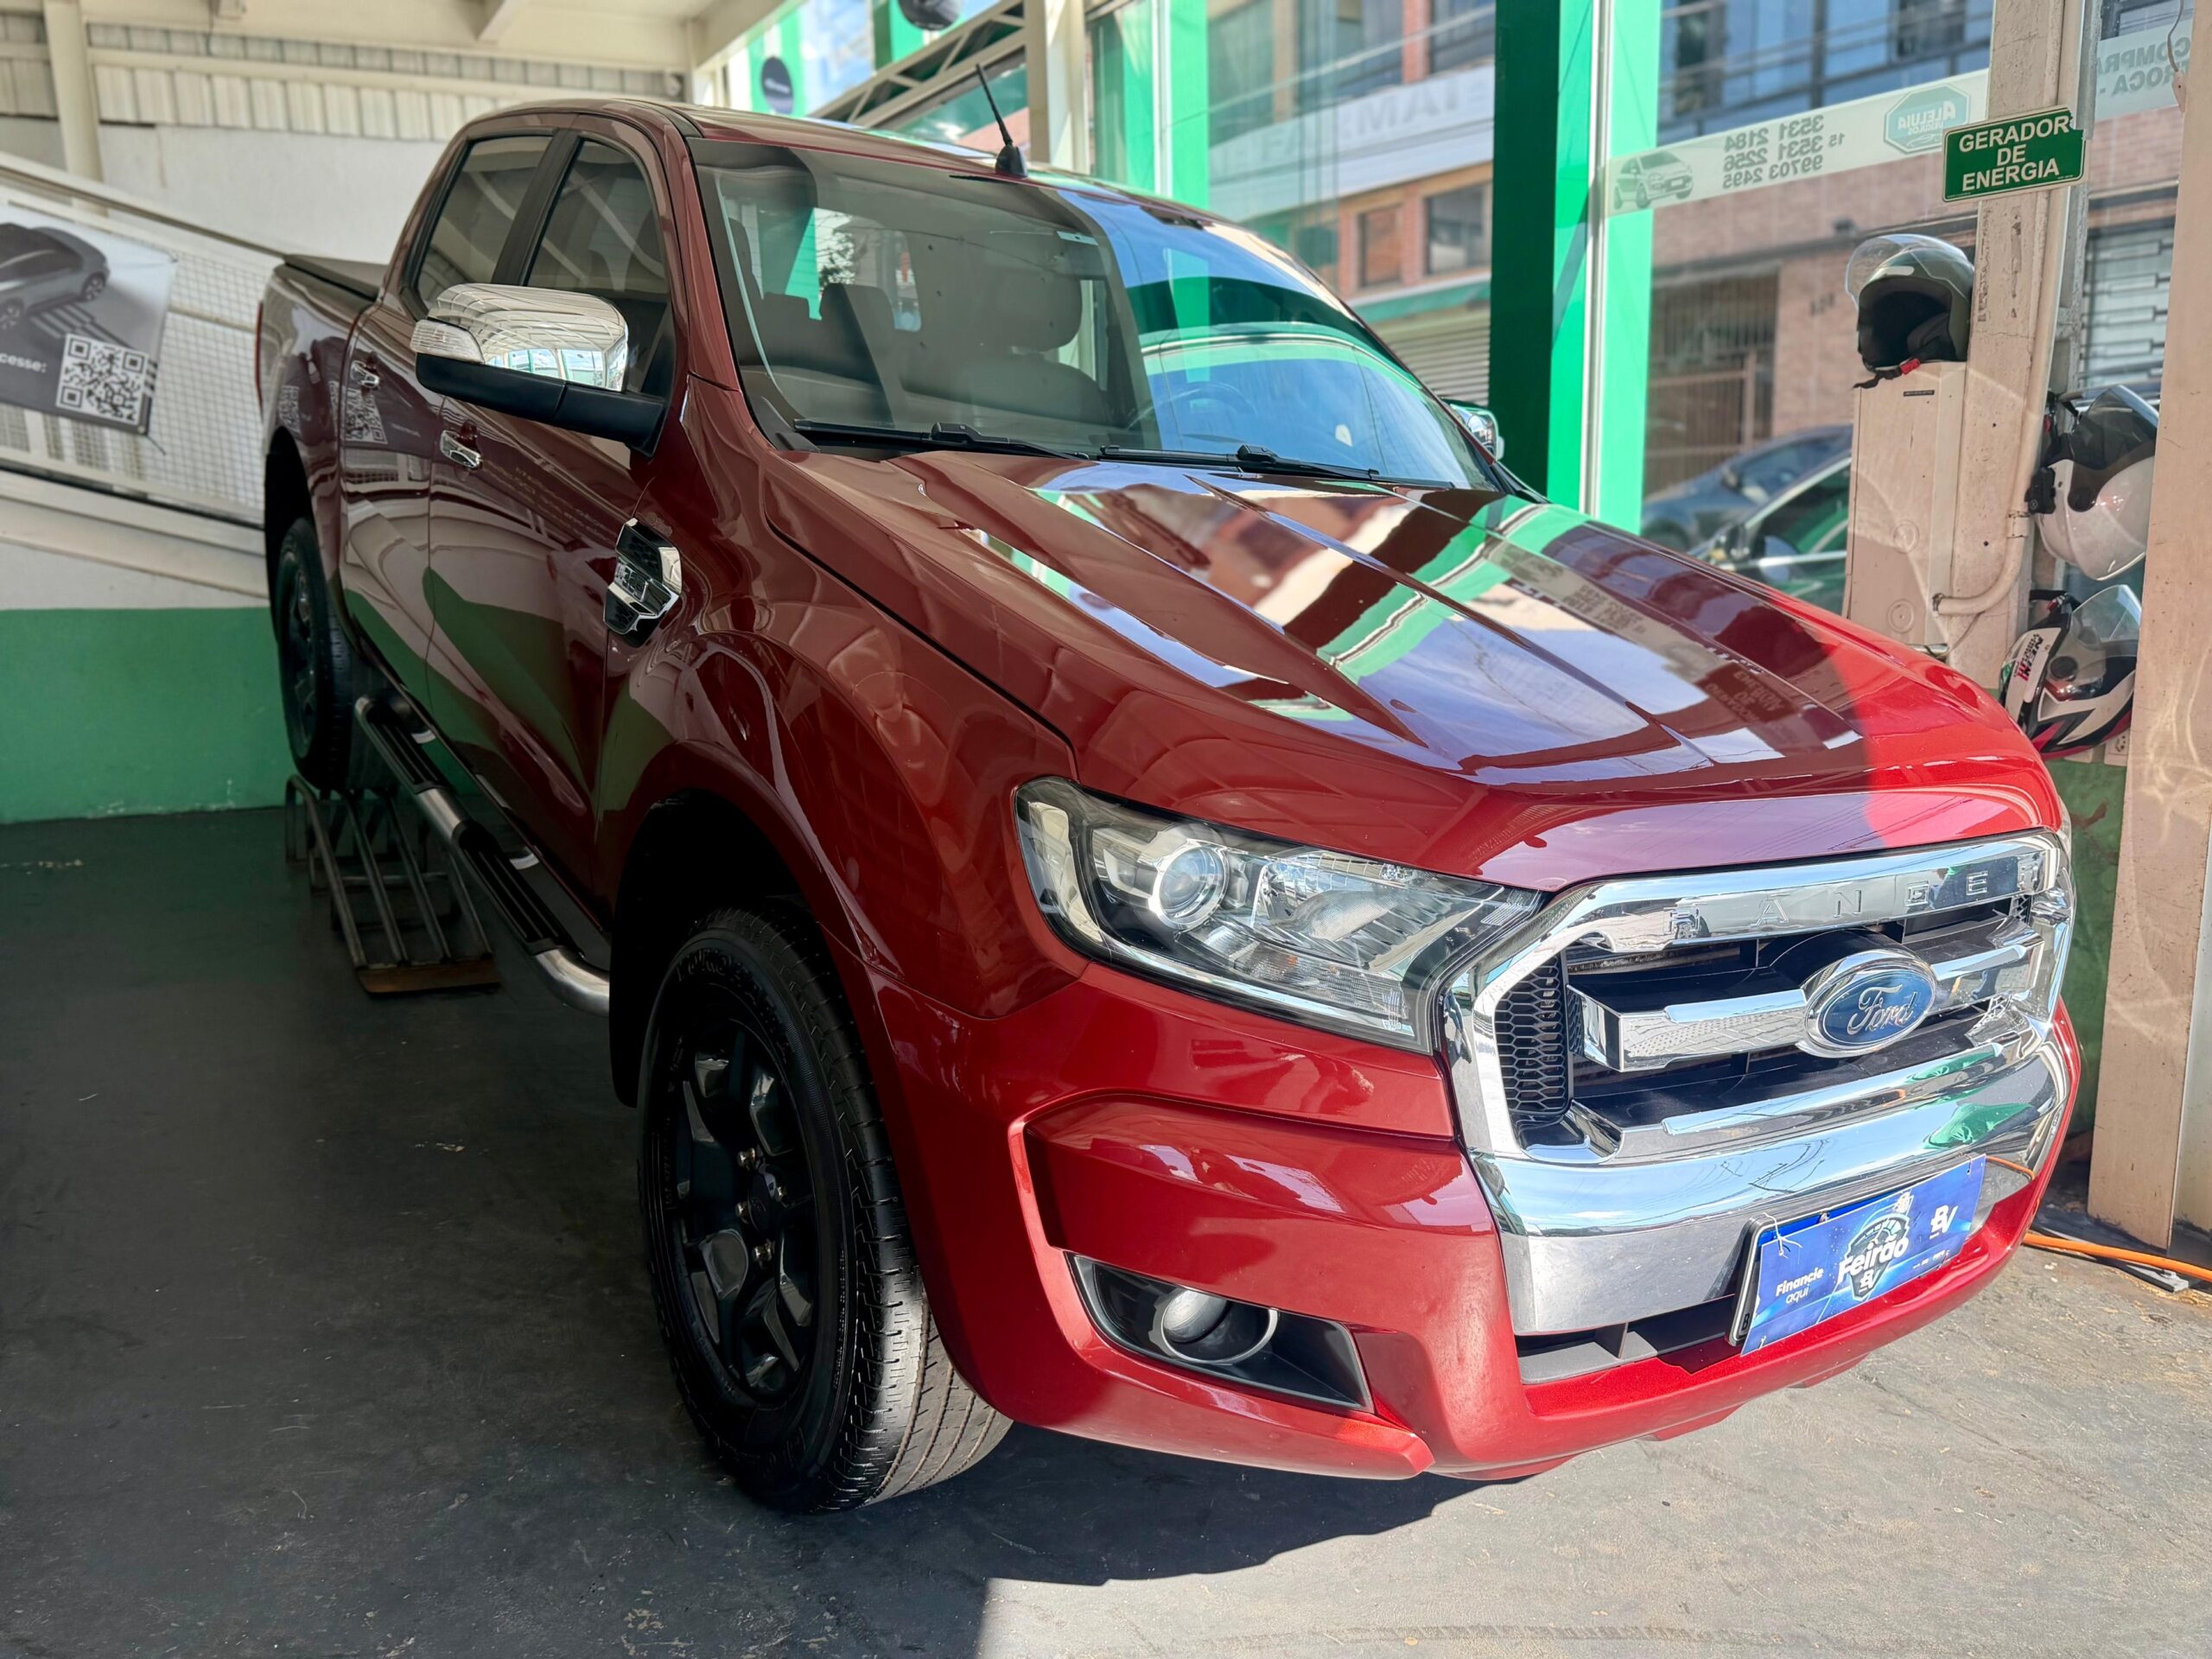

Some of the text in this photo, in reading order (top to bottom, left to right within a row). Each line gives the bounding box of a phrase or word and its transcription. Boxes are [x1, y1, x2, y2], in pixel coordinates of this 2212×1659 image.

[1959, 115, 2069, 152] GERADOR
[1997, 143, 2026, 167] DE
[1962, 158, 2060, 192] ENERGIA
[1664, 849, 2042, 937] RANGER
[1847, 983, 1918, 1036] Ford
[1837, 1233, 1910, 1285] Feirão
[1775, 1267, 1825, 1297] Financie
[1785, 1283, 1810, 1305] aqui
